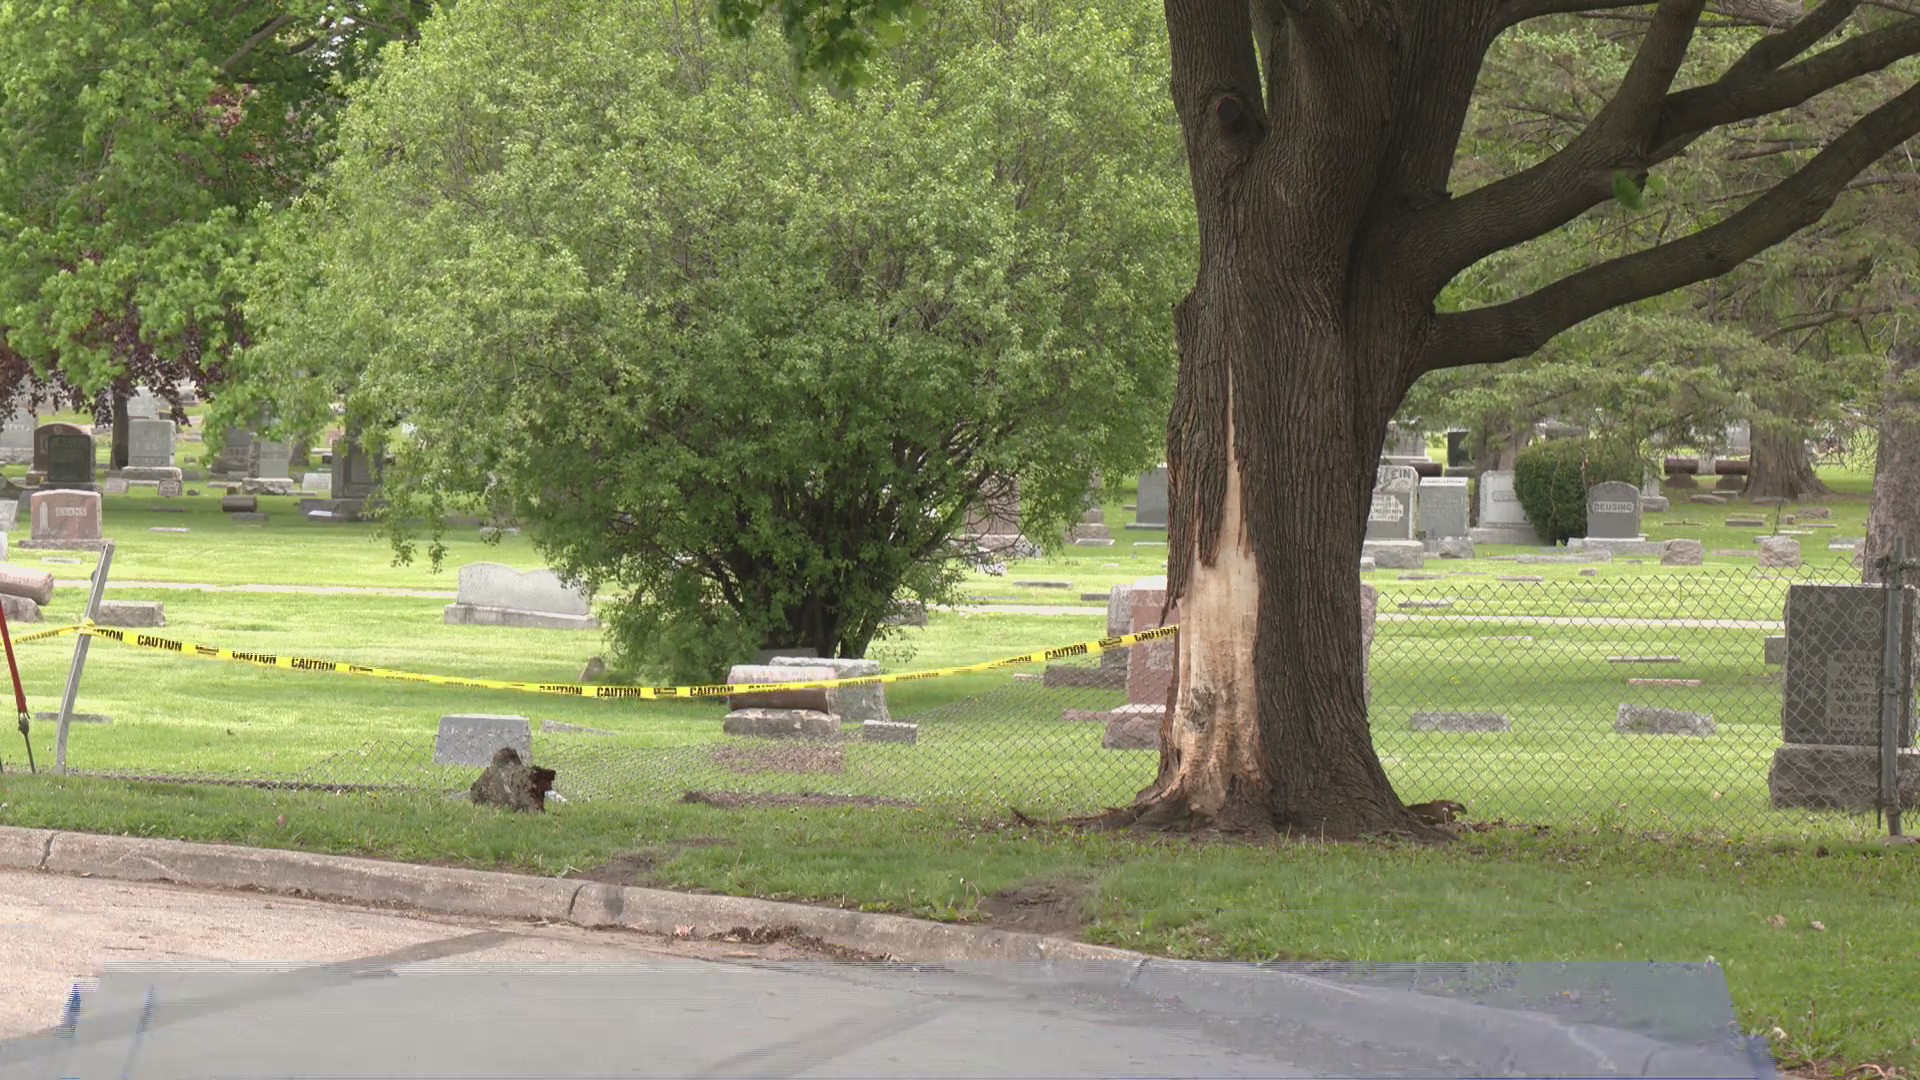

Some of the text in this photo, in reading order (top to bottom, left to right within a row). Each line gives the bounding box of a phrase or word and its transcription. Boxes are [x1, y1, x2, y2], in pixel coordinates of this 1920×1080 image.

[1594, 502, 1633, 513] DEUSING
[137, 634, 182, 651] CAUTION
[291, 656, 336, 672] CAUTION
[596, 687, 641, 698] CAUTION
[689, 686, 735, 697] CAUTION
[1045, 643, 1088, 662] CAUTION
